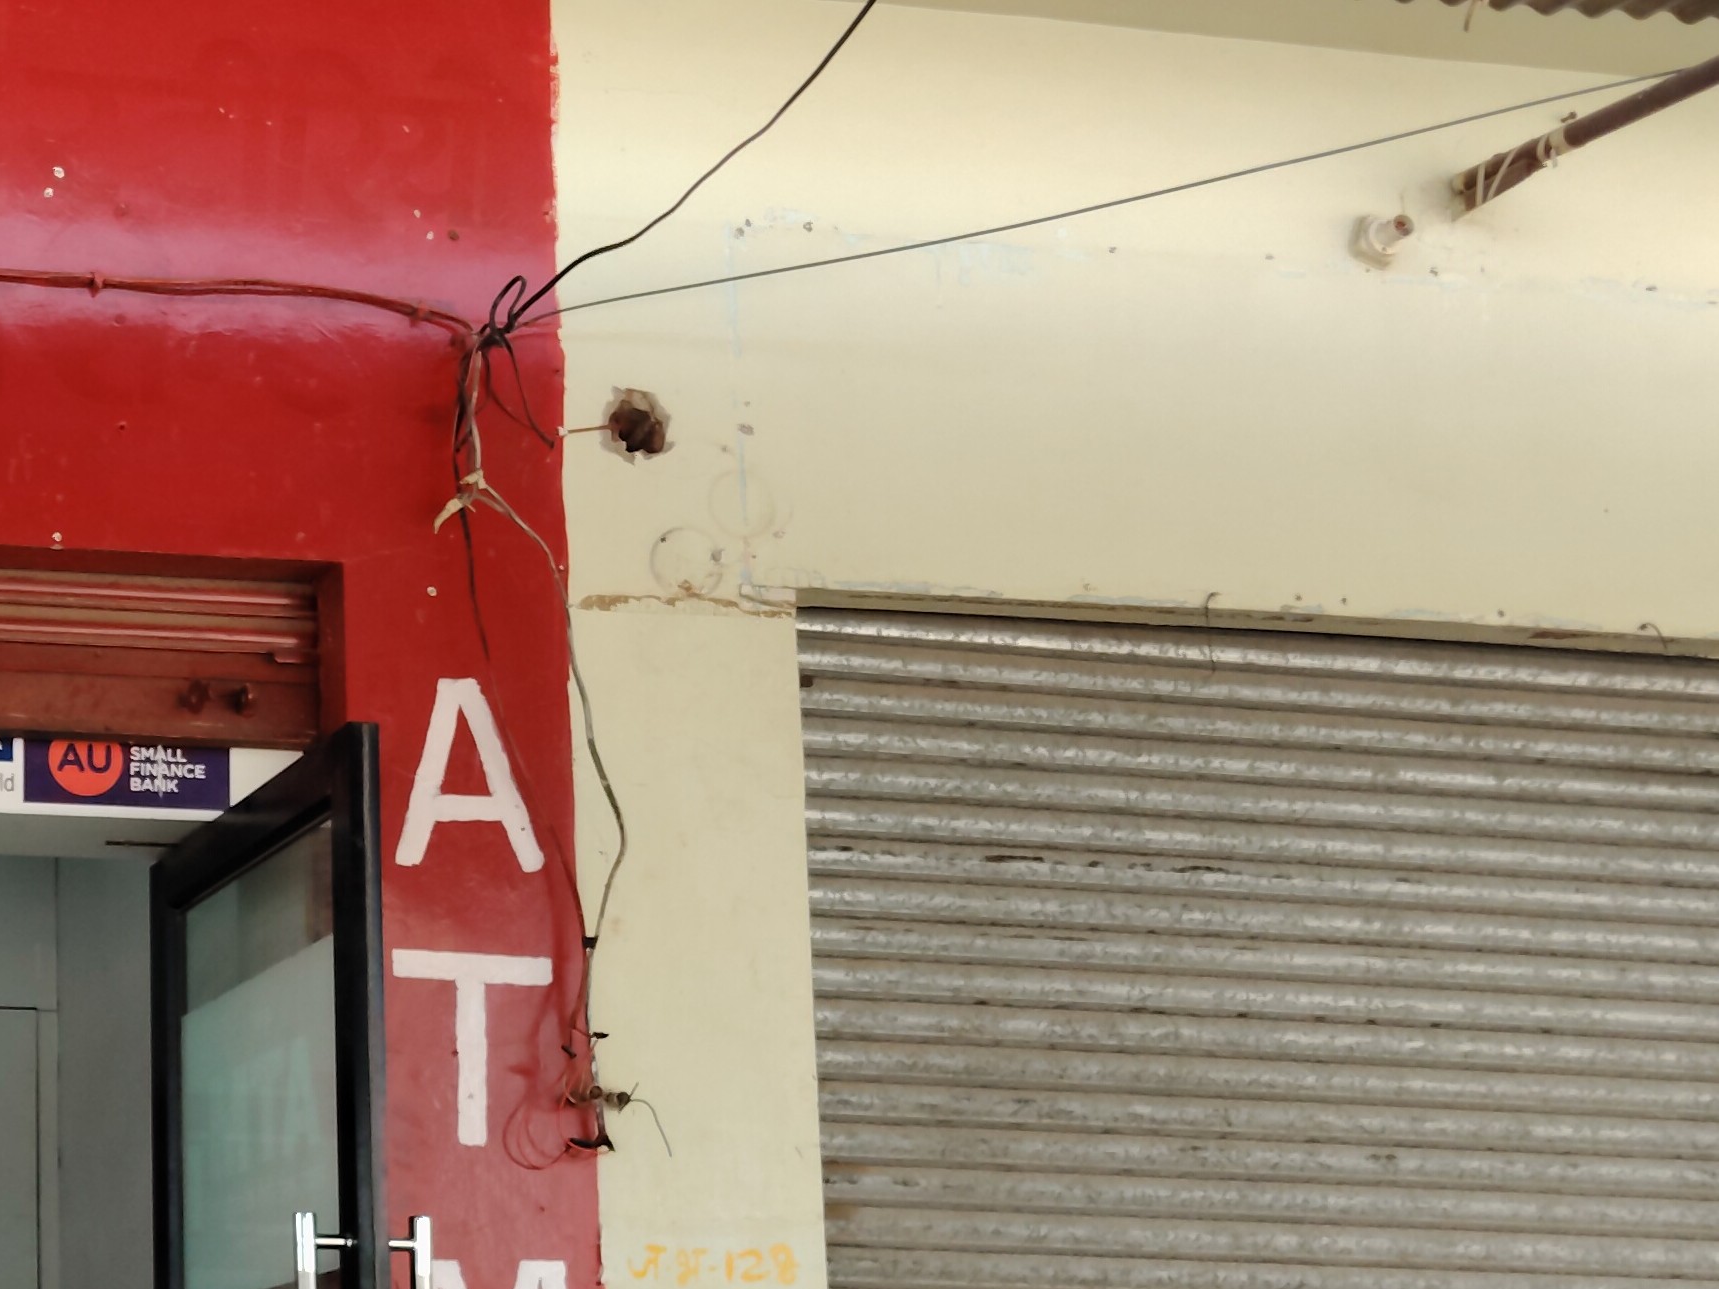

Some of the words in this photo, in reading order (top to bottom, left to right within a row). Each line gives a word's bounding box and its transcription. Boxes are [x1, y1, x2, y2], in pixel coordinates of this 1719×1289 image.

[57, 742, 113, 774] AU
[130, 746, 188, 763] SMALL
[130, 762, 206, 779] FINANCE
[130, 777, 179, 793] BANK
